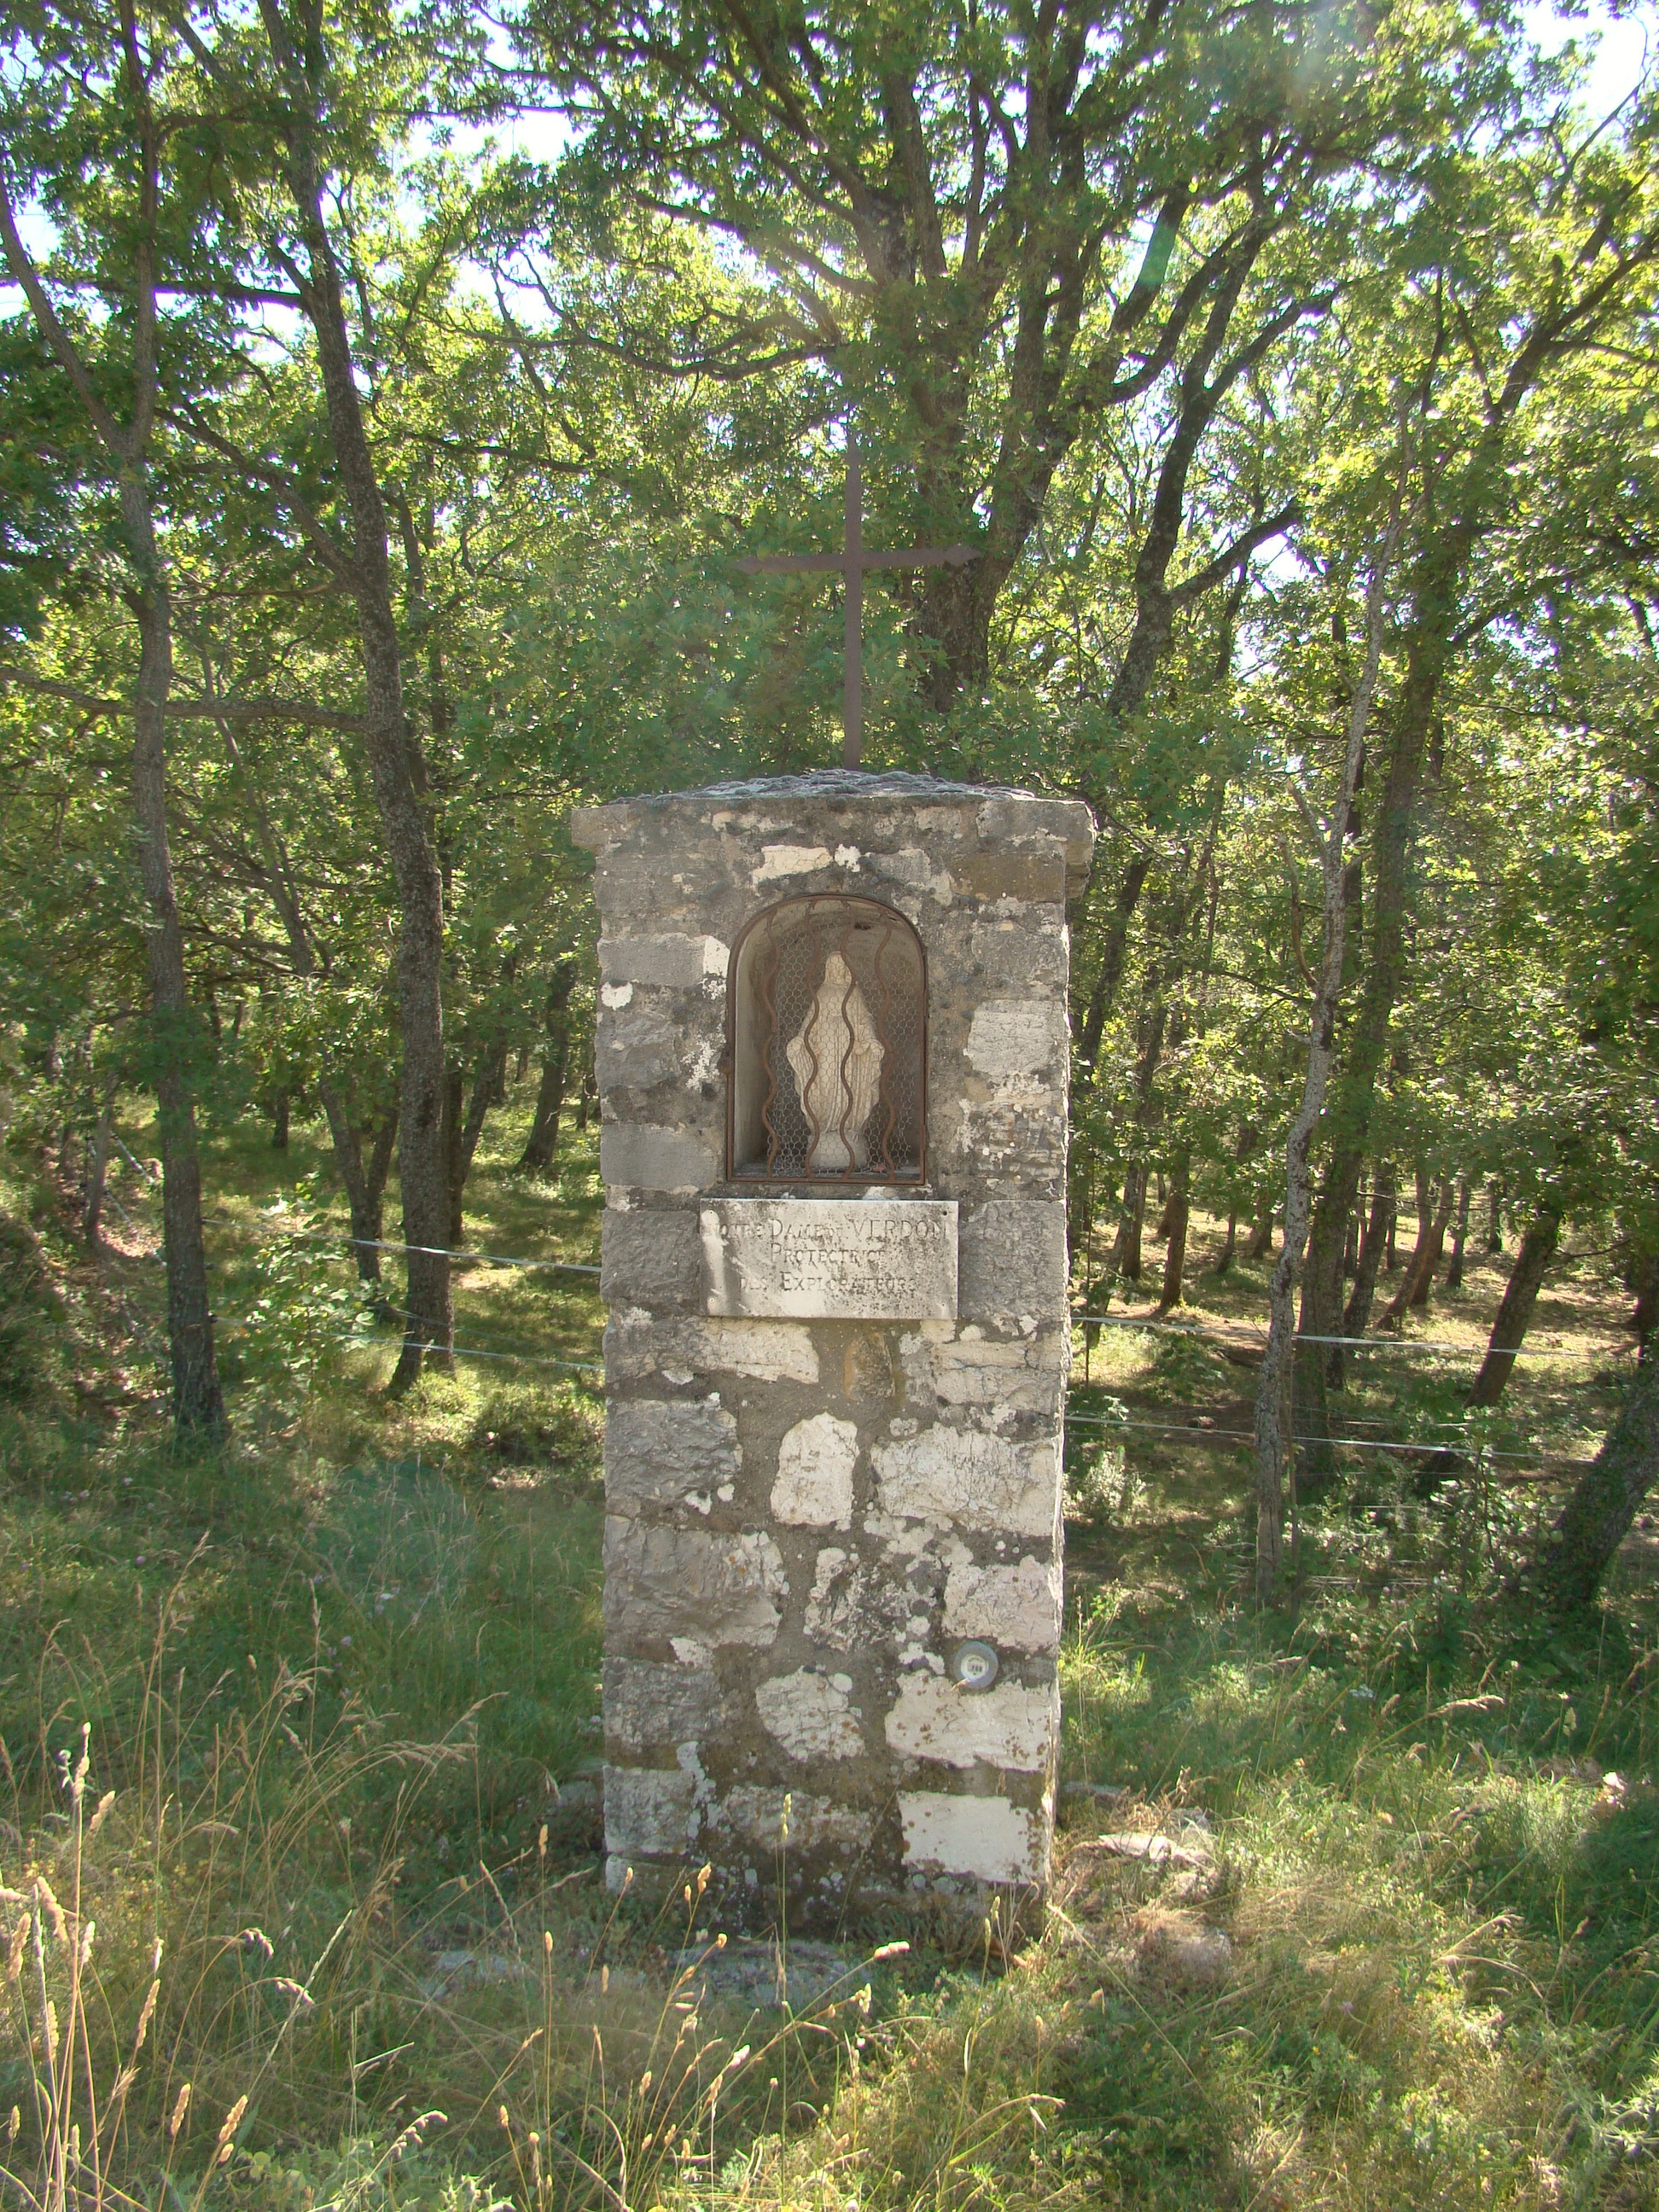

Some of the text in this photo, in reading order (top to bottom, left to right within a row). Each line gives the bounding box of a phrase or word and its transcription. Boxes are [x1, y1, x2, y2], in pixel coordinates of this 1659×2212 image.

[769, 1218, 825, 1240] DAME
[847, 1218, 946, 1239] VERDON
[770, 1243, 886, 1265] PROTECTRICE
